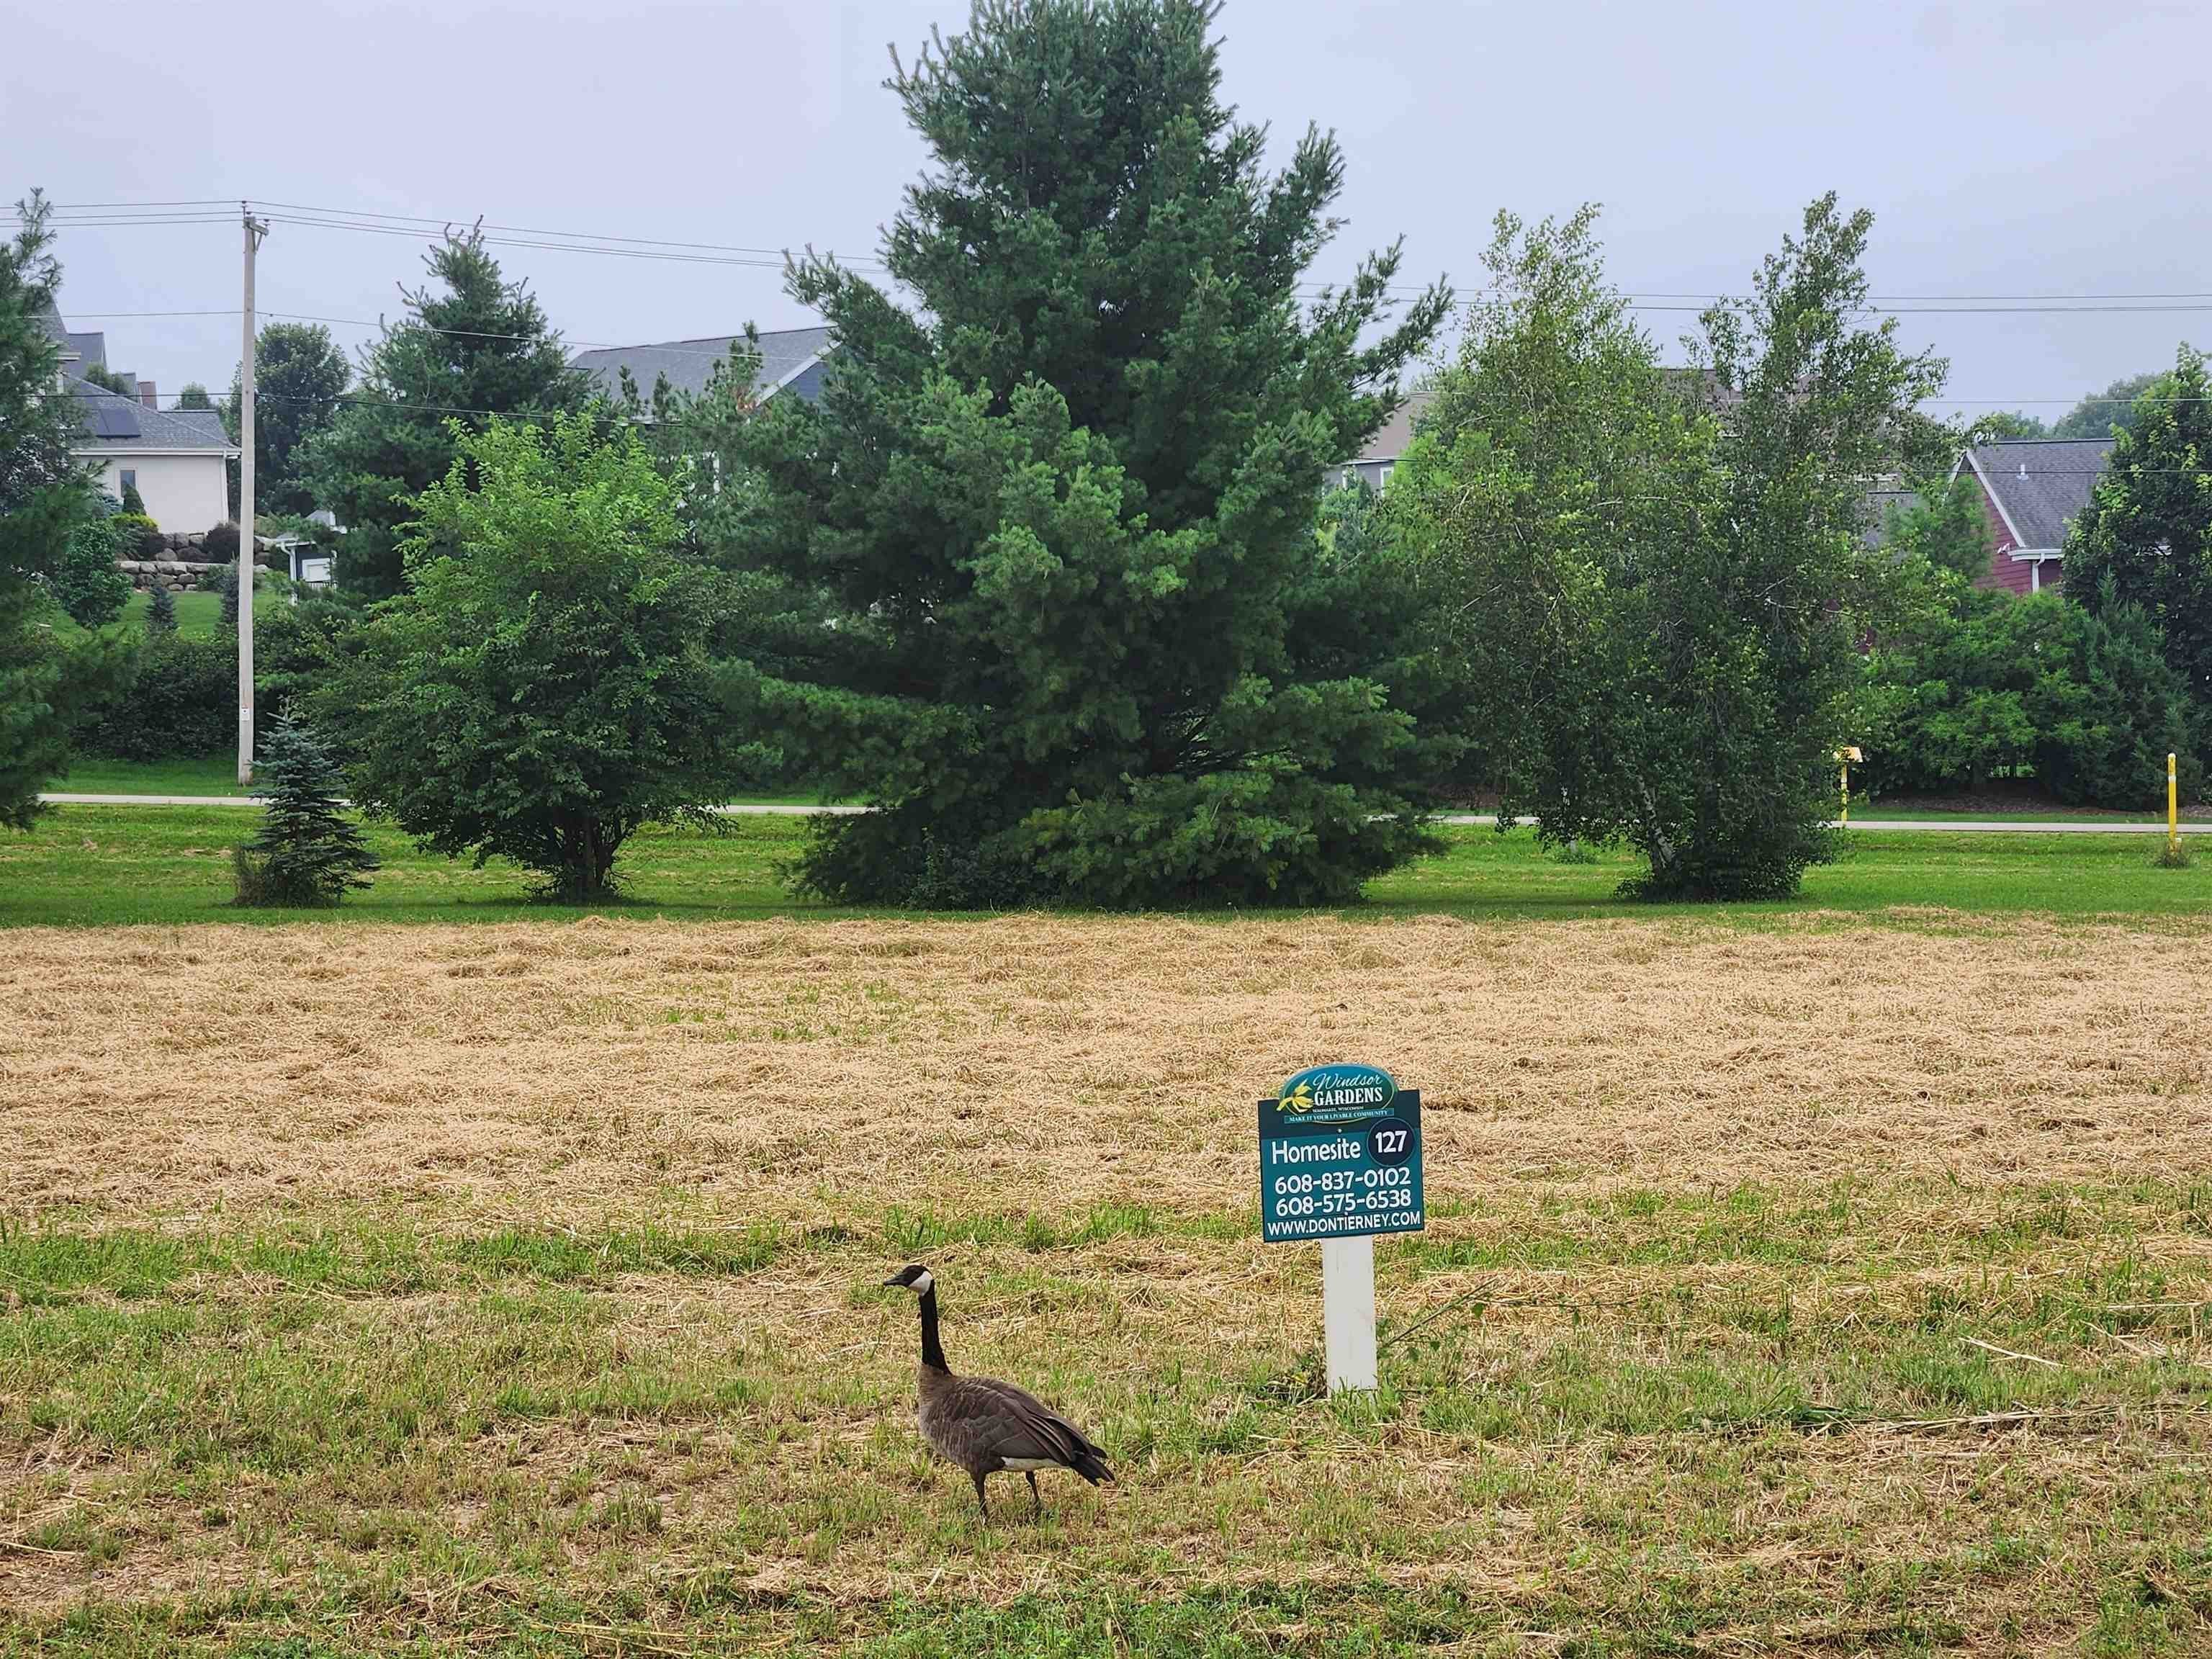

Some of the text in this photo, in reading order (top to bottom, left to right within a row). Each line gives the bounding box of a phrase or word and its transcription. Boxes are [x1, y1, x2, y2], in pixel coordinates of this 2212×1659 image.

[1313, 1073, 1382, 1091] Windsor
[1314, 1087, 1382, 1107] GARDENS
[1353, 1110, 1388, 1118] COMMUNITY
[1272, 1130, 1407, 1164] Homesite 127
[1274, 1166, 1411, 1195] 608-837-0102
[1276, 1188, 1411, 1217] 608-575-6538
[1267, 1210, 1421, 1236] WWW.DONTIERNEY.COM
